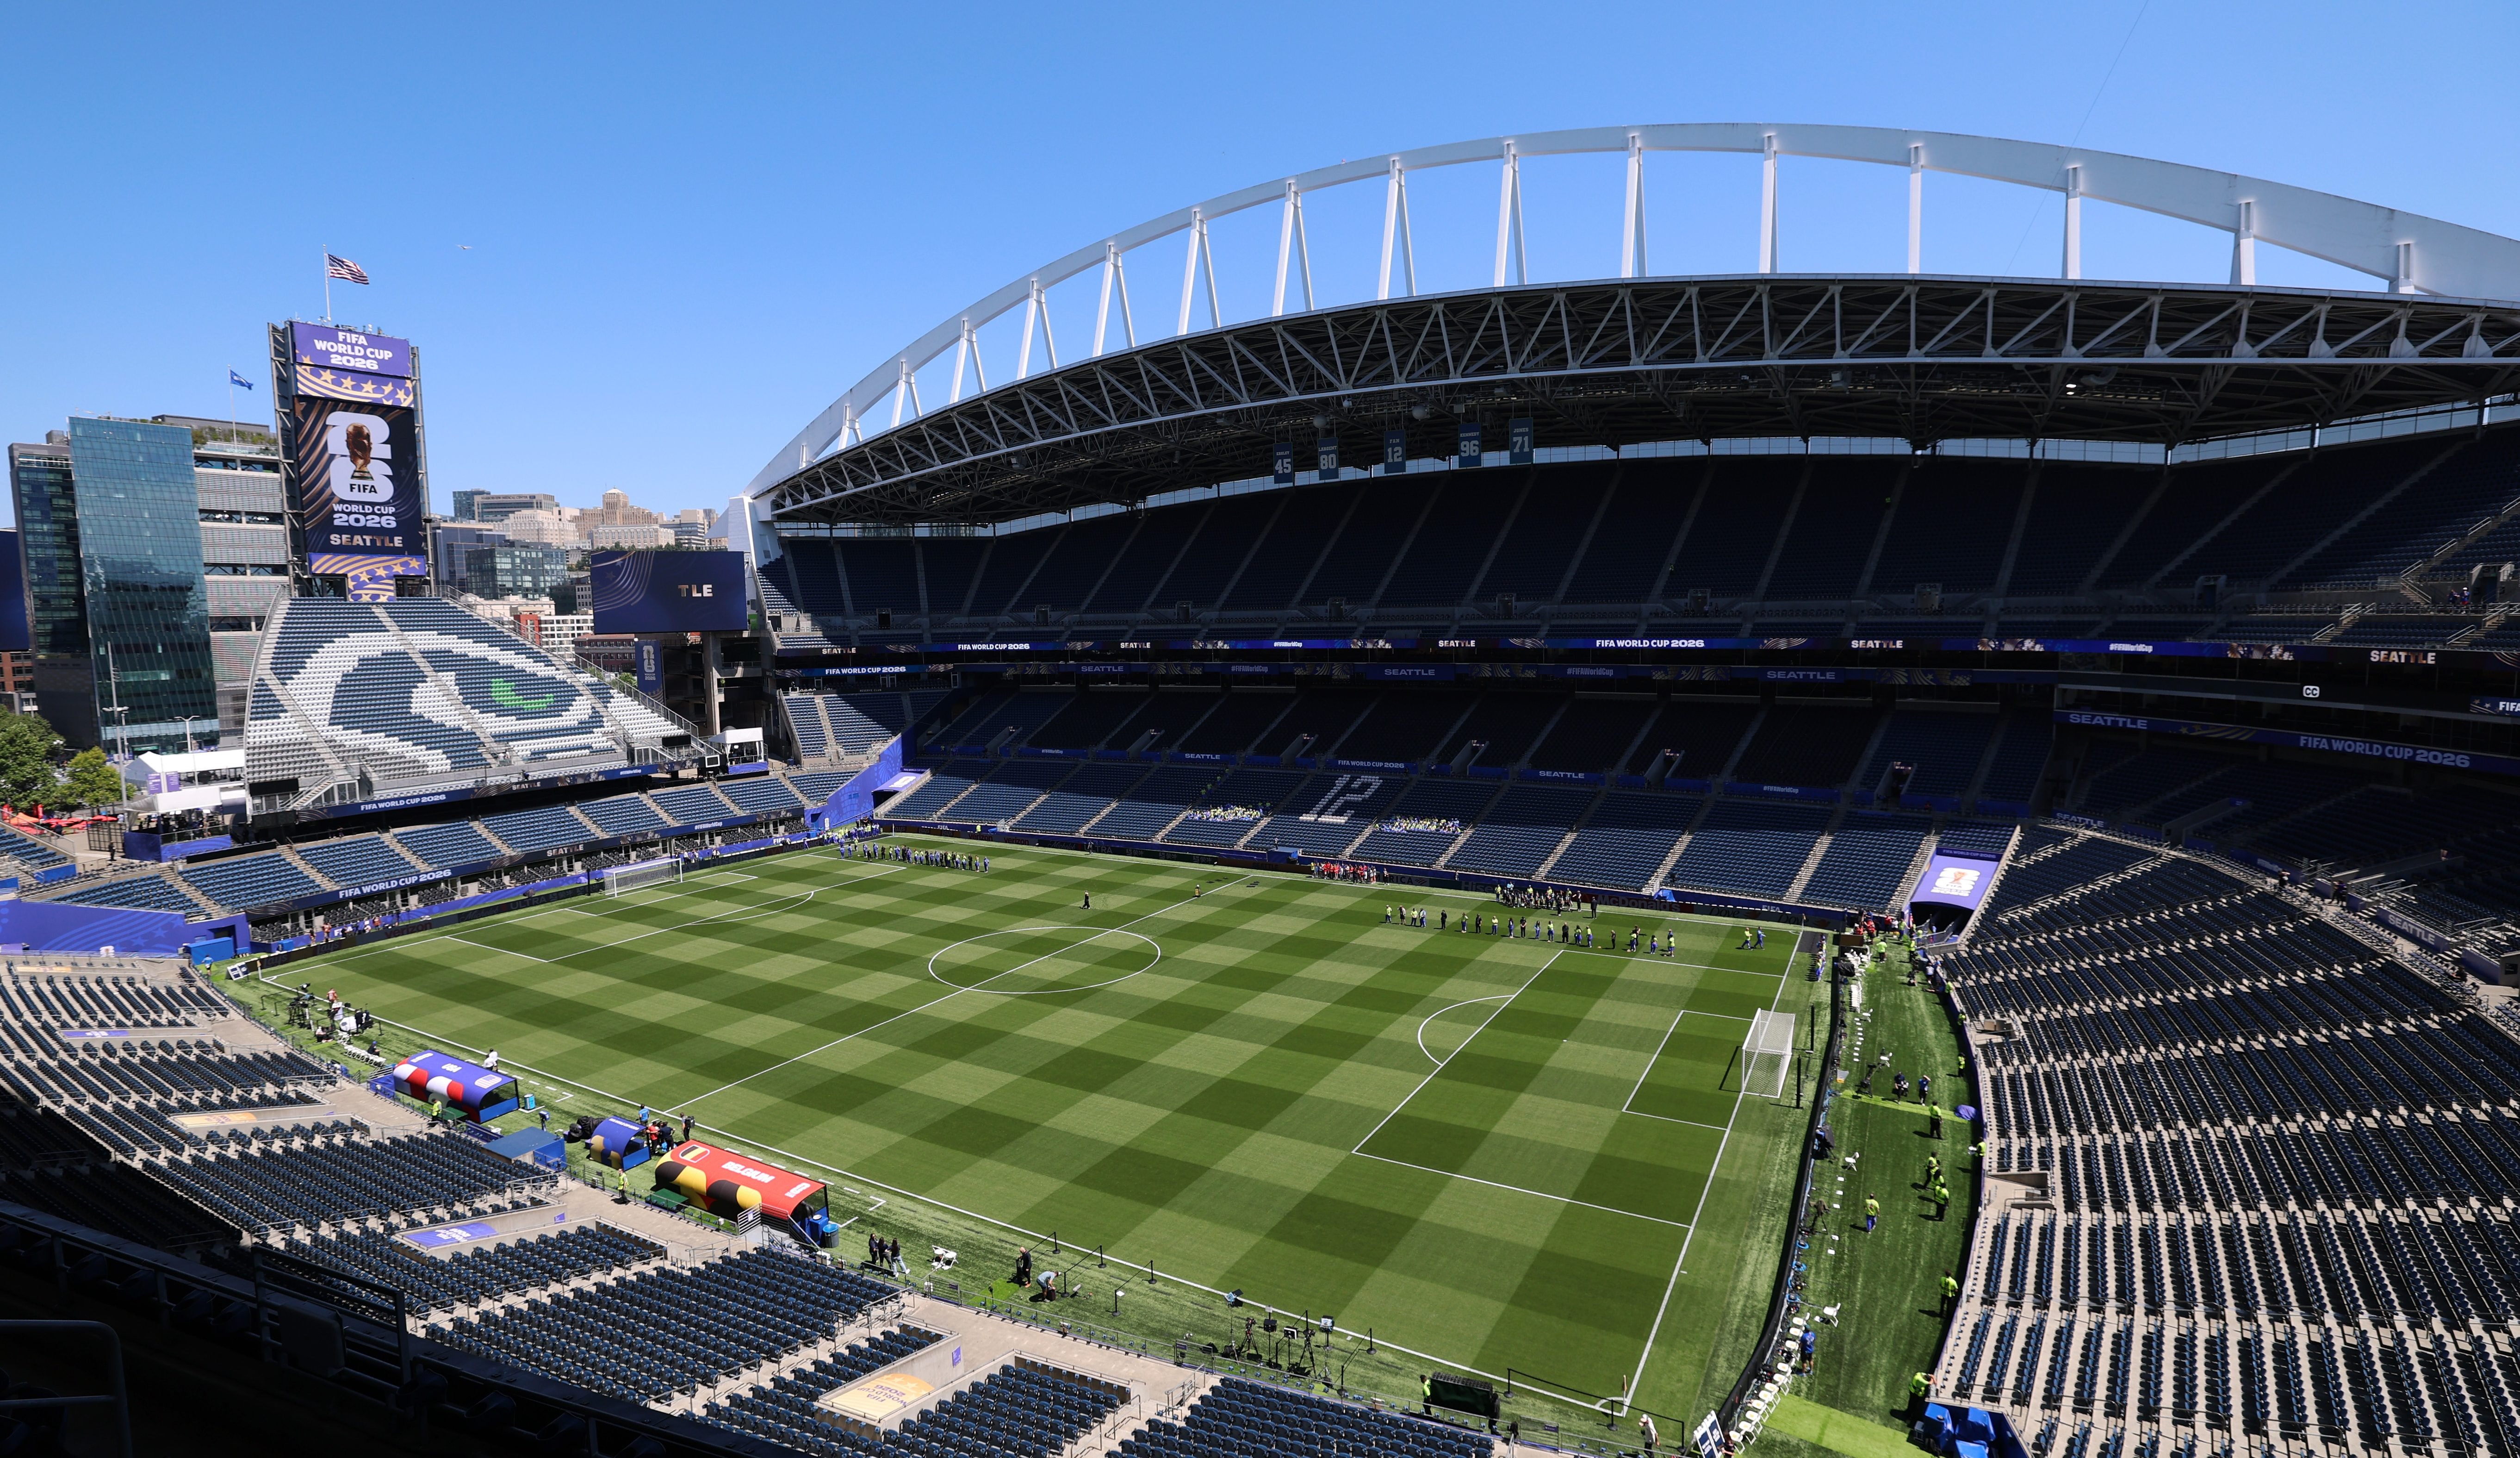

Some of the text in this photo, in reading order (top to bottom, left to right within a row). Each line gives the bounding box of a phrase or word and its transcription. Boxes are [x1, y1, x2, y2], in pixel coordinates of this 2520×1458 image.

[338, 331, 368, 346] FIFA
[314, 339, 393, 361] WORLD CUP
[330, 354, 379, 370] 2026
[1460, 440, 1479, 457] 96
[1513, 436, 1530, 453] 71
[1387, 446, 1403, 463] 12
[1274, 458, 1291, 474] 45
[1320, 454, 1337, 470] 80
[349, 483, 378, 494] FIFA
[332, 503, 396, 515] WORLD CUP
[333, 513, 397, 529] 2026
[330, 534, 403, 548] SEATTLE
[691, 584, 714, 597] LE
[1596, 639, 1705, 648] FIFA WORLD CUP 2026
[1851, 640, 1903, 649] SEATTLE
[2370, 650, 2436, 665] SEATTLE
[1231, 665, 1269, 673] #FIFAWorldCup
[1566, 667, 1614, 676] #FIFAWorldCup
[1767, 671, 1836, 679] SEATTLE
[2499, 701, 2520, 712] FIFA
[2069, 713, 2148, 730] SEATTLE
[2299, 735, 2471, 768] FIFA WORLD CUP 2026
[1539, 770, 1585, 779] SEATTLE
[512, 781, 541, 791] SEATTLE
[1763, 785, 1800, 794] #FIFAWorldCup
[378, 800, 405, 810] WORLD
[421, 794, 447, 803] 2026
[695, 821, 723, 830] #FIFAWorldCup
[968, 833, 993, 842] verizon
[1004, 836, 1030, 846] verizon
[546, 844, 584, 857] SEATTLE
[783, 837, 825, 852] McDoald's
[709, 852, 756, 867] Hisense
[339, 868, 453, 899] FIFA WORLD CUP 2026
[510, 895, 546, 910] ULTRA
[1596, 895, 1681, 912] McDonald's
[1709, 906, 1740, 917] Dove
[1778, 912, 1809, 925] Dove
[334, 926, 353, 937] FIA
[385, 921, 433, 939] verizon
[2388, 913, 2435, 946] SEATTLE
[441, 1063, 463, 1073] USA
[721, 1161, 776, 1184] BELGIUM
[874, 1384, 906, 1397] 2026
[866, 1394, 886, 1402] FIFA
